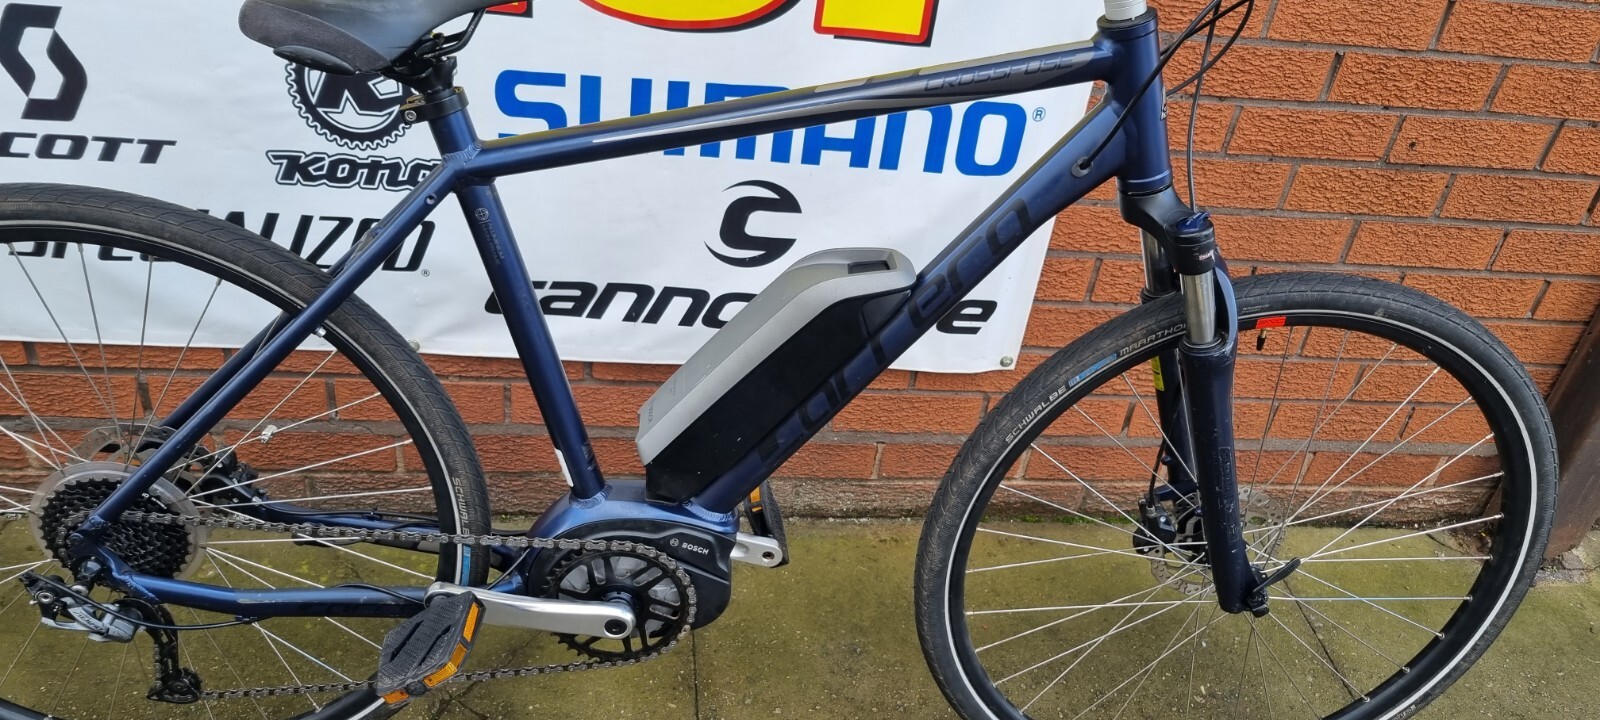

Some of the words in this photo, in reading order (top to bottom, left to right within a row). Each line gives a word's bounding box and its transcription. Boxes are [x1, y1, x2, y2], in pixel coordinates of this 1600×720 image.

[1119, 322, 1186, 356] MARATHO
[1005, 385, 1067, 443] SCHWALBE
[451, 476, 471, 536] SCHWALB
[681, 542, 709, 556] BOSCH
